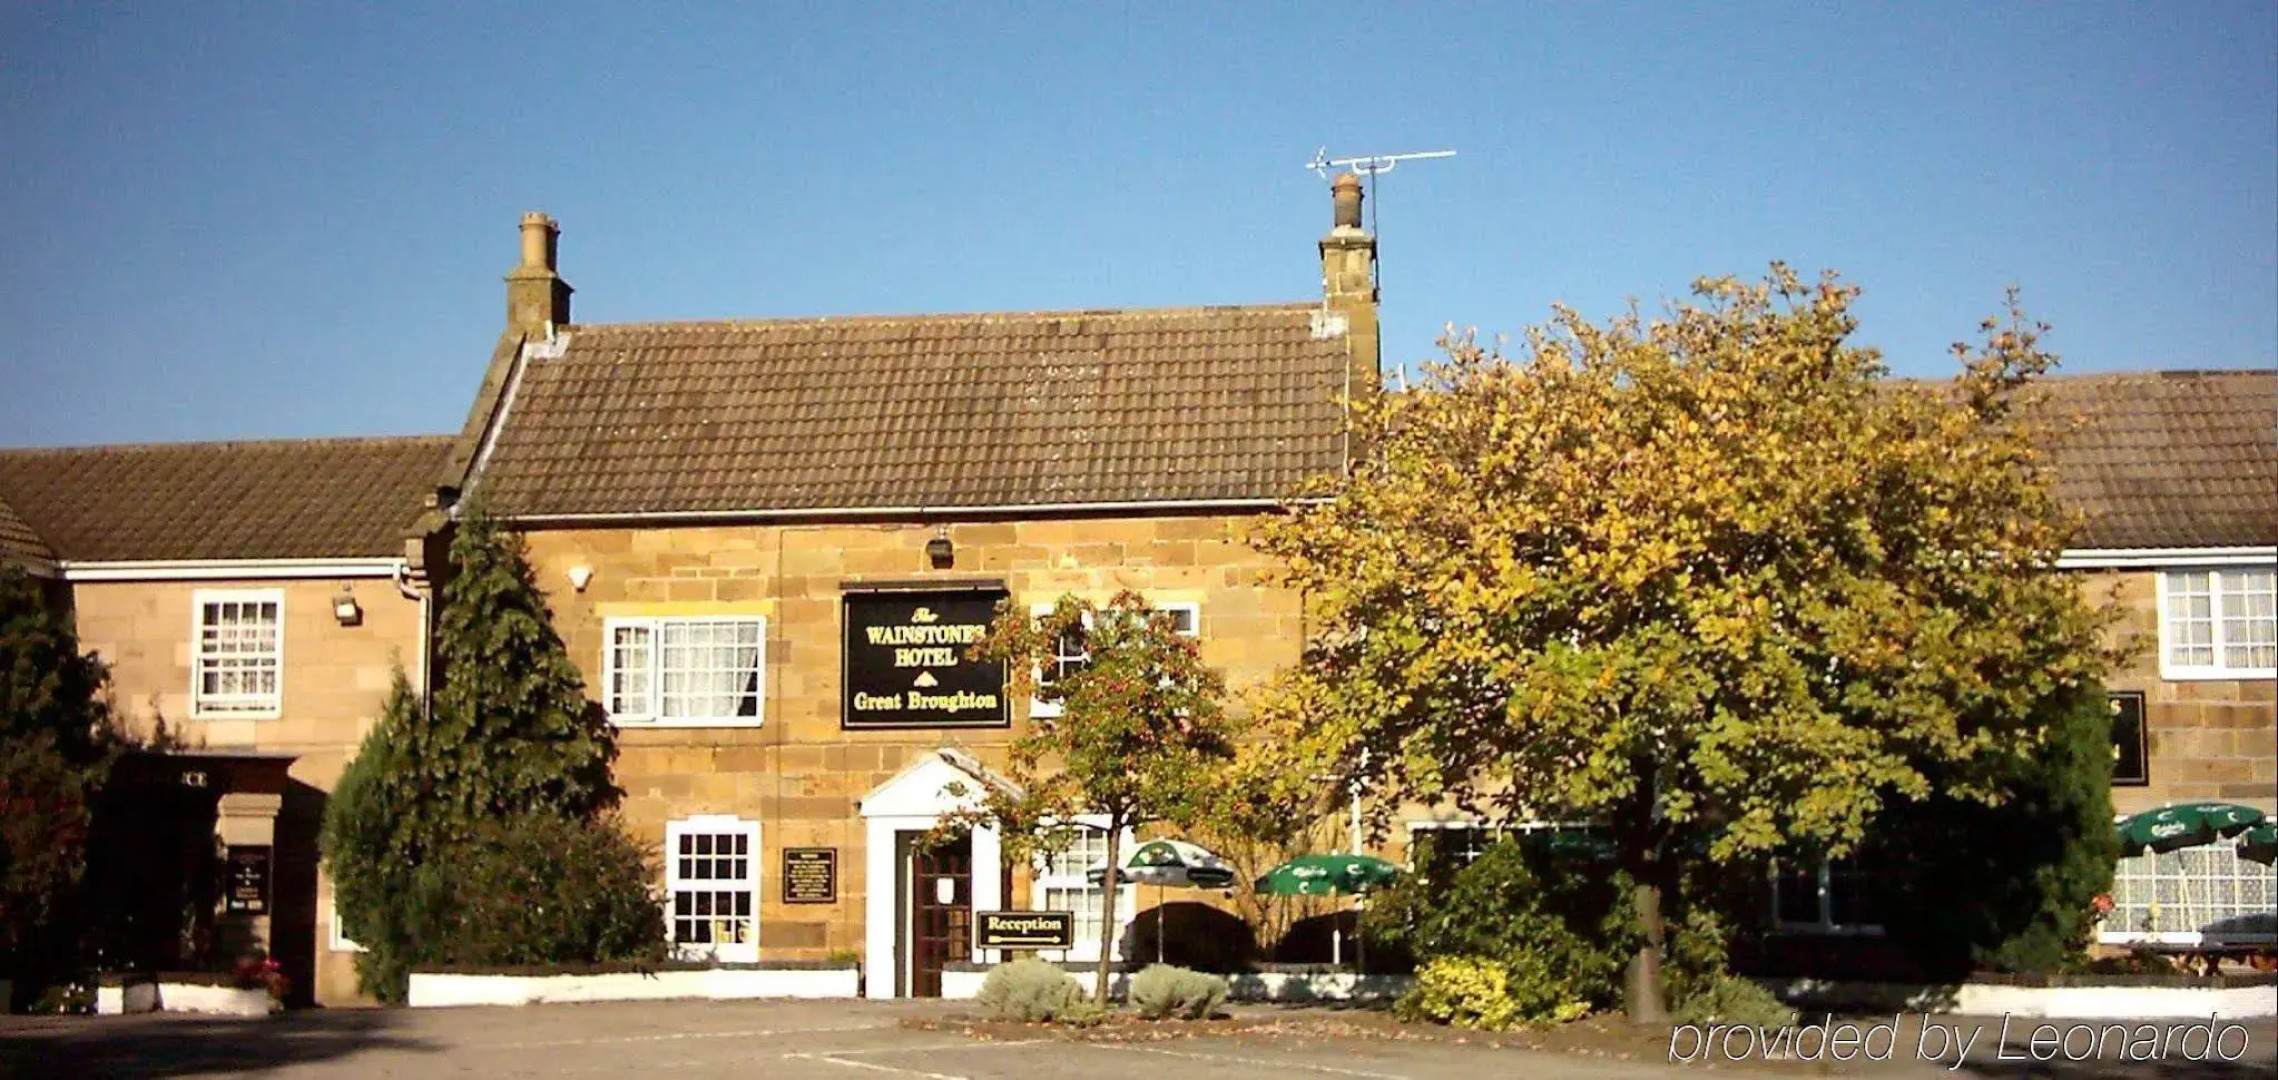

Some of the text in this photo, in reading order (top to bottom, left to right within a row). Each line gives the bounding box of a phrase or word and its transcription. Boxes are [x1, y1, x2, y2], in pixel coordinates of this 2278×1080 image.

[911, 607, 938, 623] The
[894, 648, 958, 667] HOTEL
[854, 690, 997, 713] Great Broughton
[988, 916, 1062, 934] Reception
